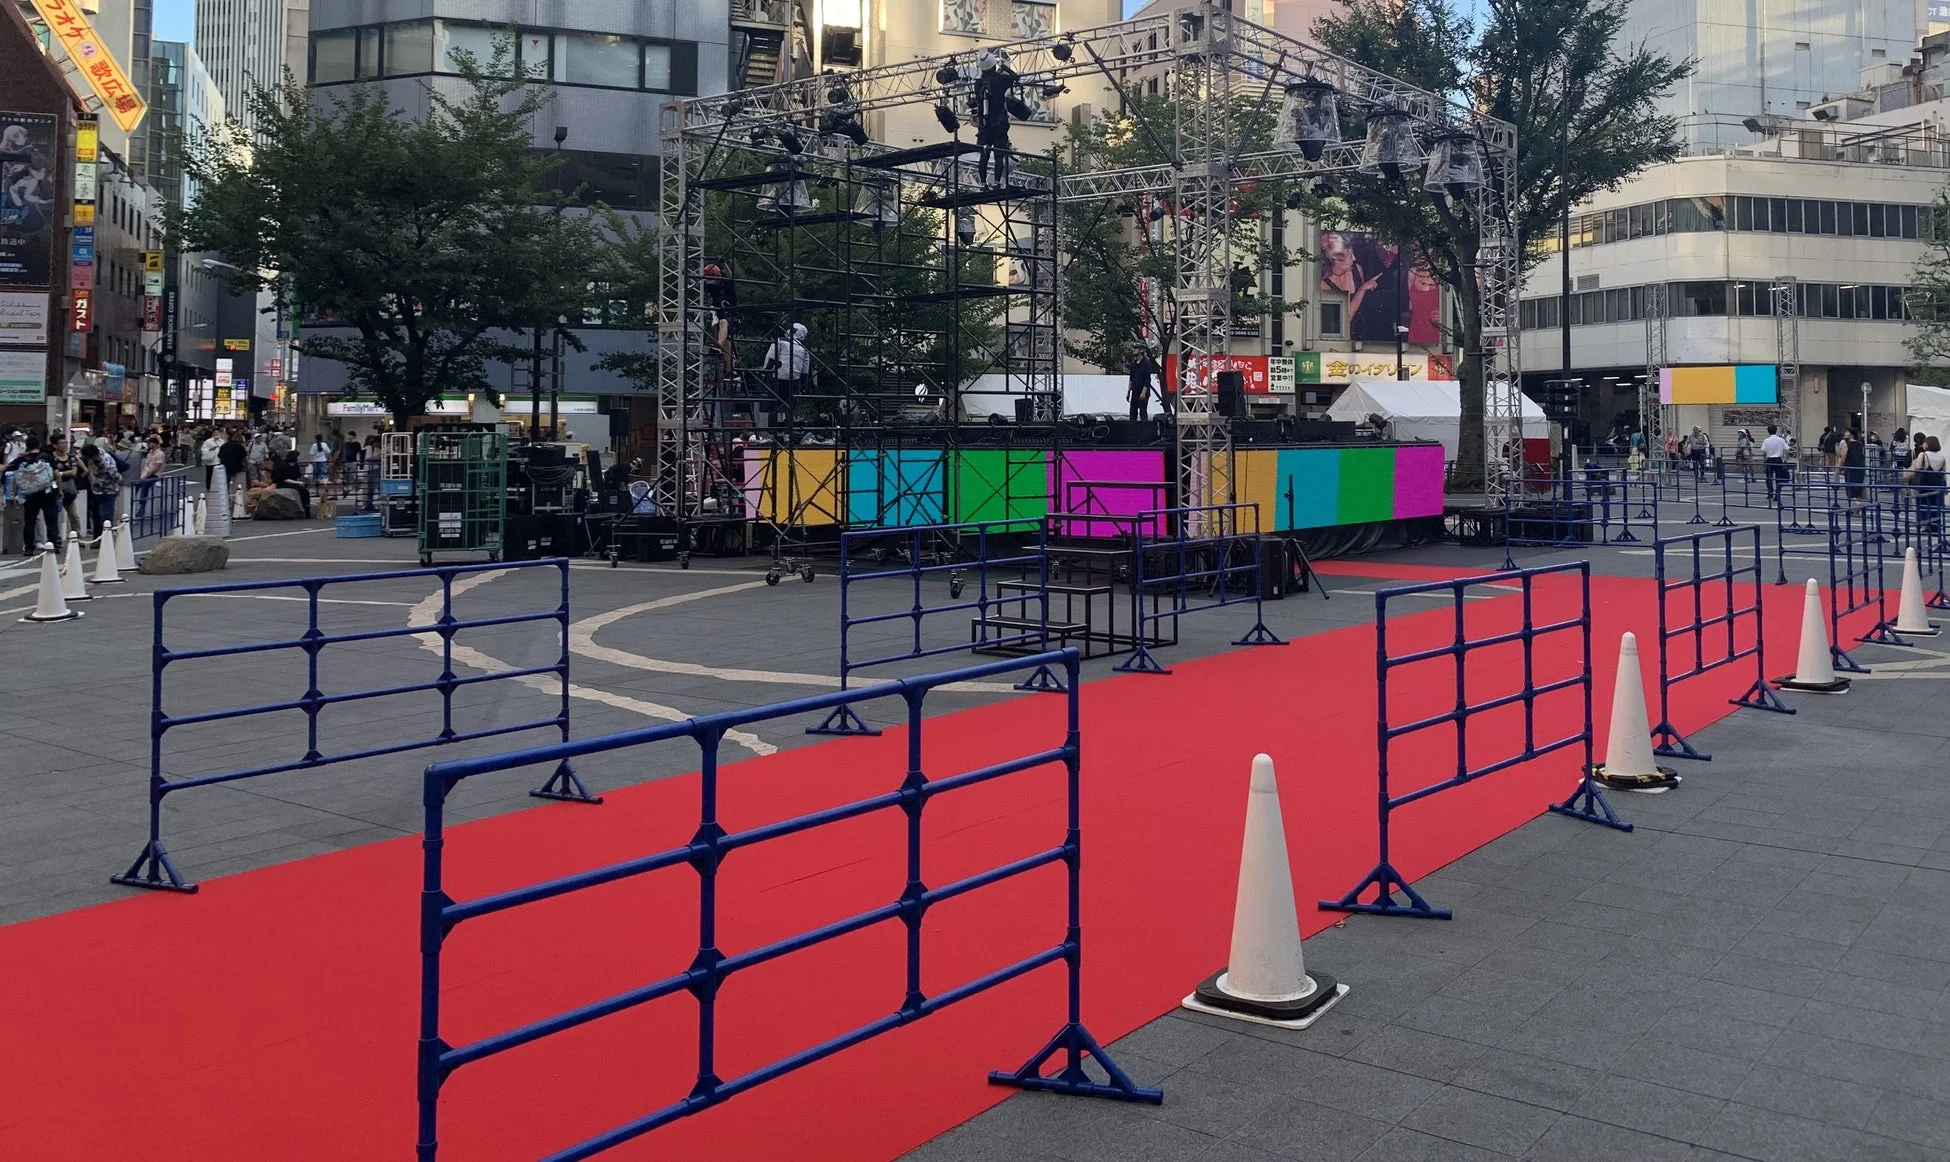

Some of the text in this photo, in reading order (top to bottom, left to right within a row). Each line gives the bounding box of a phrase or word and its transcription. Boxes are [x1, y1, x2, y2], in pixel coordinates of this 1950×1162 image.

[90, 59, 137, 114] 歌広場
[76, 299, 88, 330] ガスト
[343, 403, 378, 413] FamilyMart
